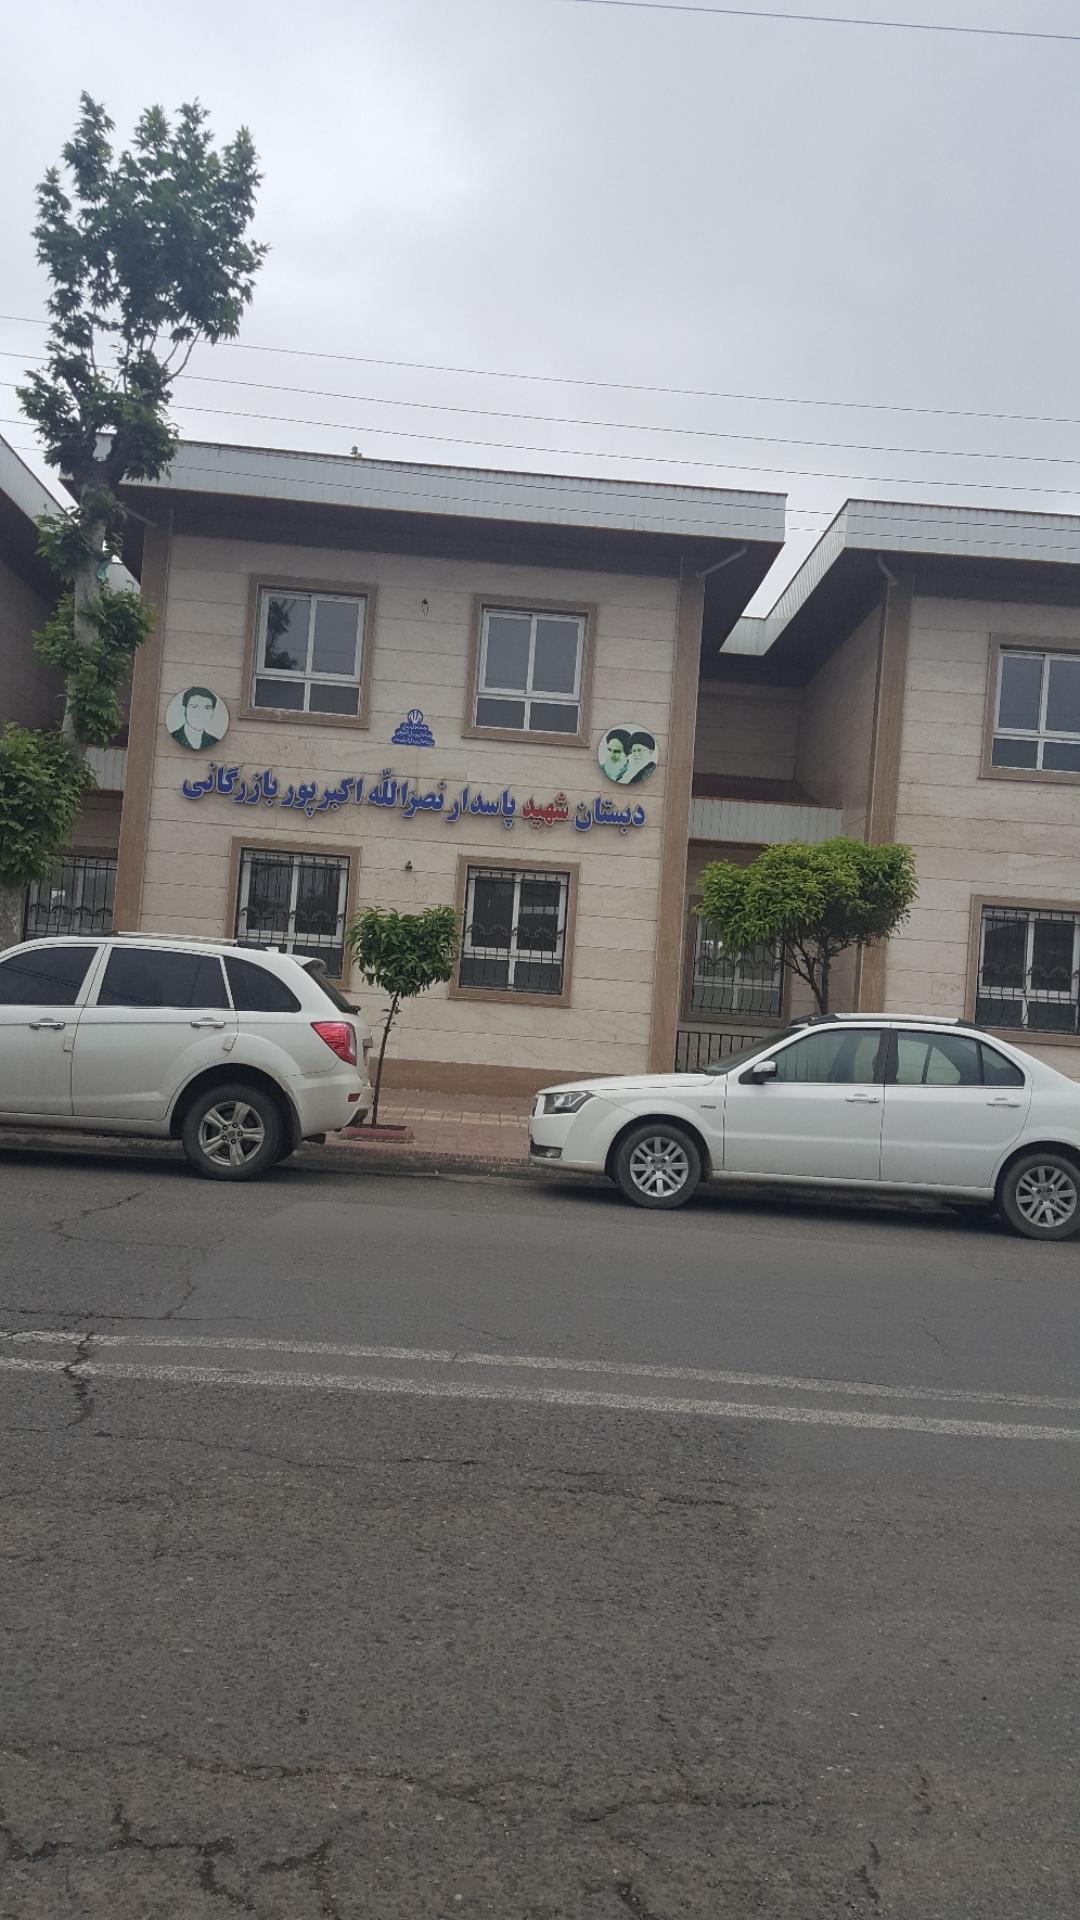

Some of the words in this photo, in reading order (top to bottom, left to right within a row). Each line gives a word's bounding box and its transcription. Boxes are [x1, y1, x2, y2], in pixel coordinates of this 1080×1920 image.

[182, 761, 280, 807] بازرگانی
[446, 786, 516, 830] پاسدار
[522, 791, 570, 828] شهید
[575, 795, 646, 834] دبستان
